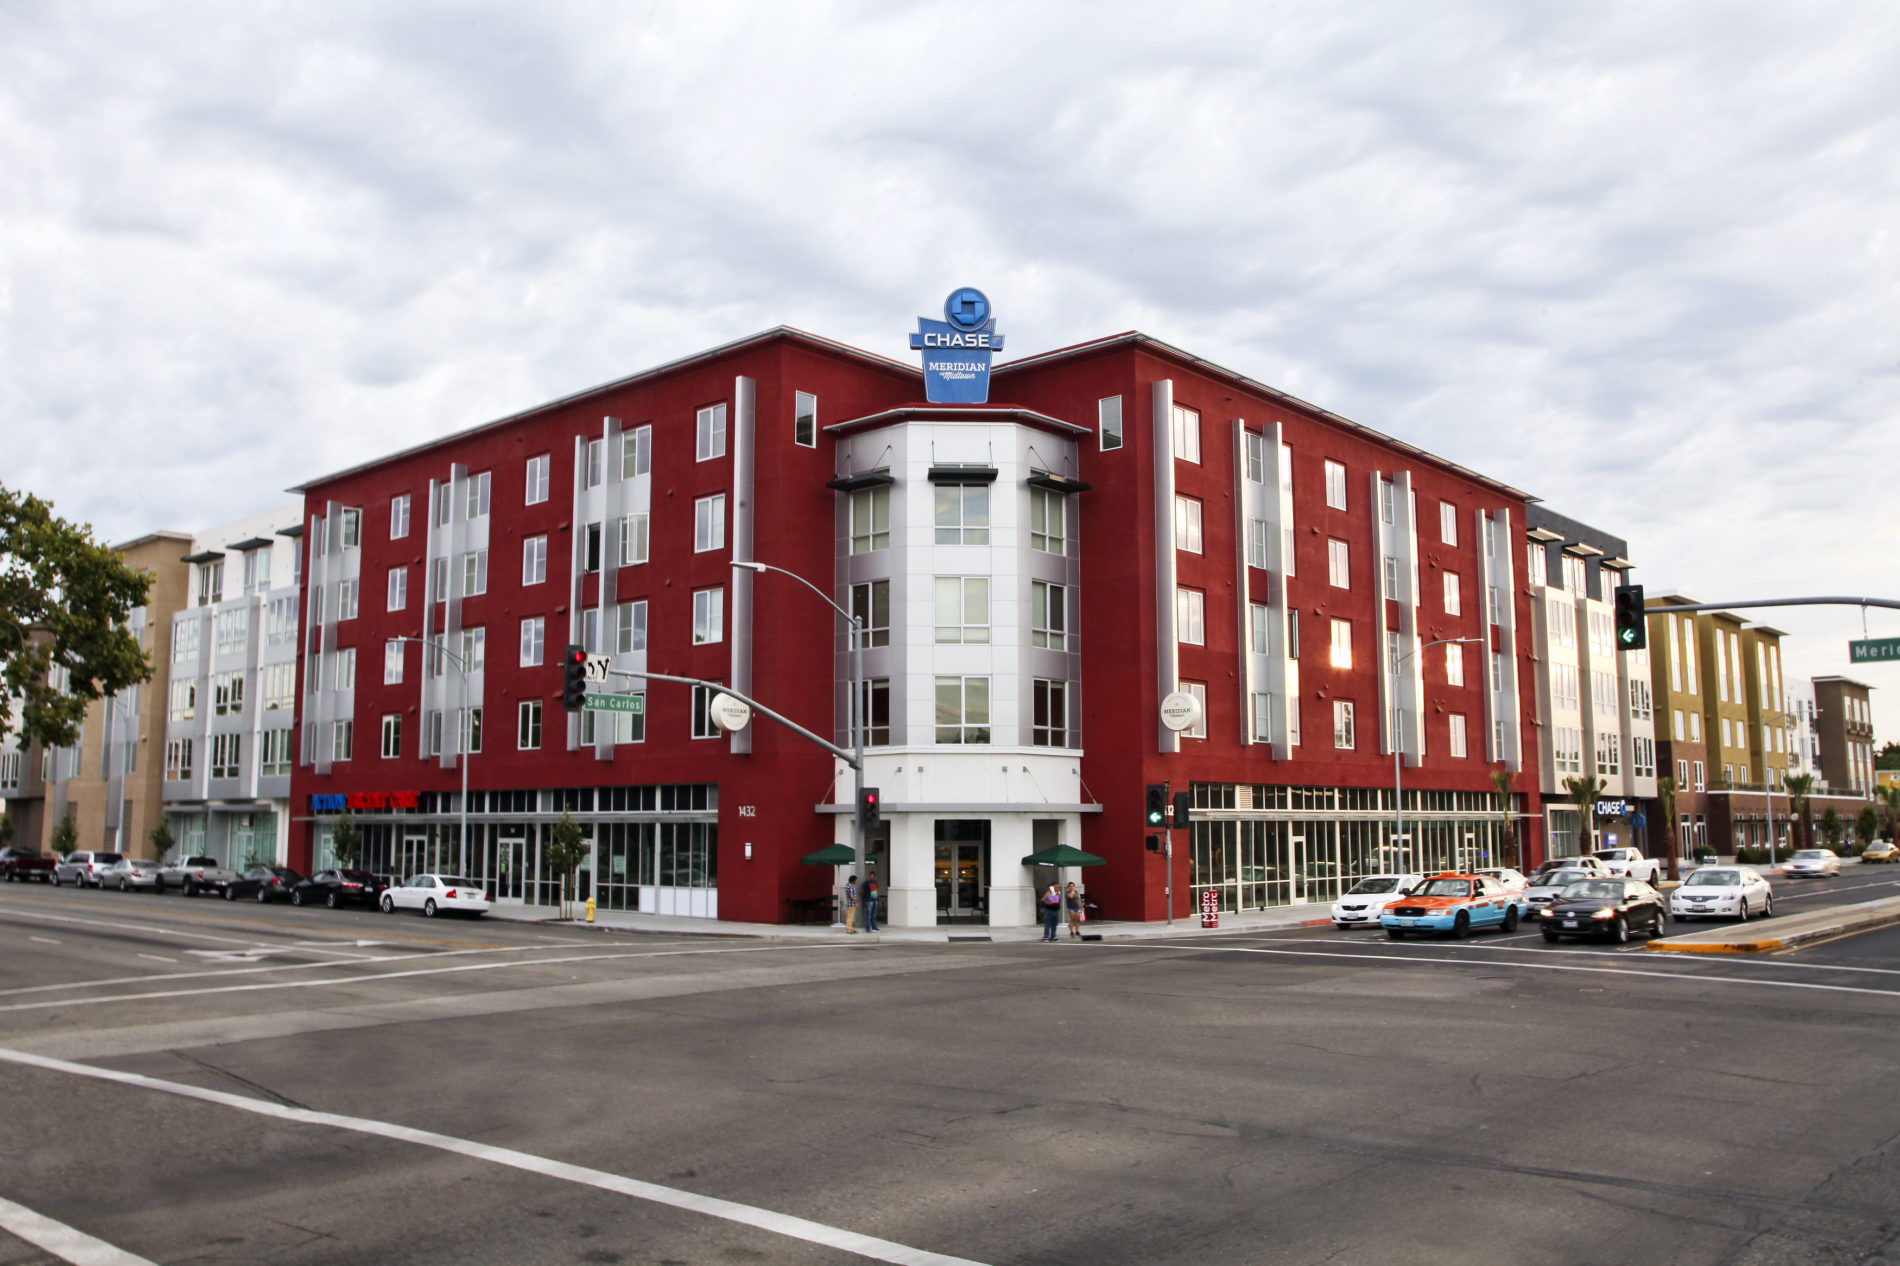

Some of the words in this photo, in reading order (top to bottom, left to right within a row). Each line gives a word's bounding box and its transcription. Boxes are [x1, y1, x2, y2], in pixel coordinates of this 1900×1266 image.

[924, 333, 990, 347] CHASE
[929, 362, 986, 372] MERIDIAN
[587, 697, 605, 707] San
[610, 698, 640, 710] Carlos
[738, 805, 756, 816] 1432
[1597, 801, 1621, 815] CHASE
[1201, 891, 1210, 922] Metro
